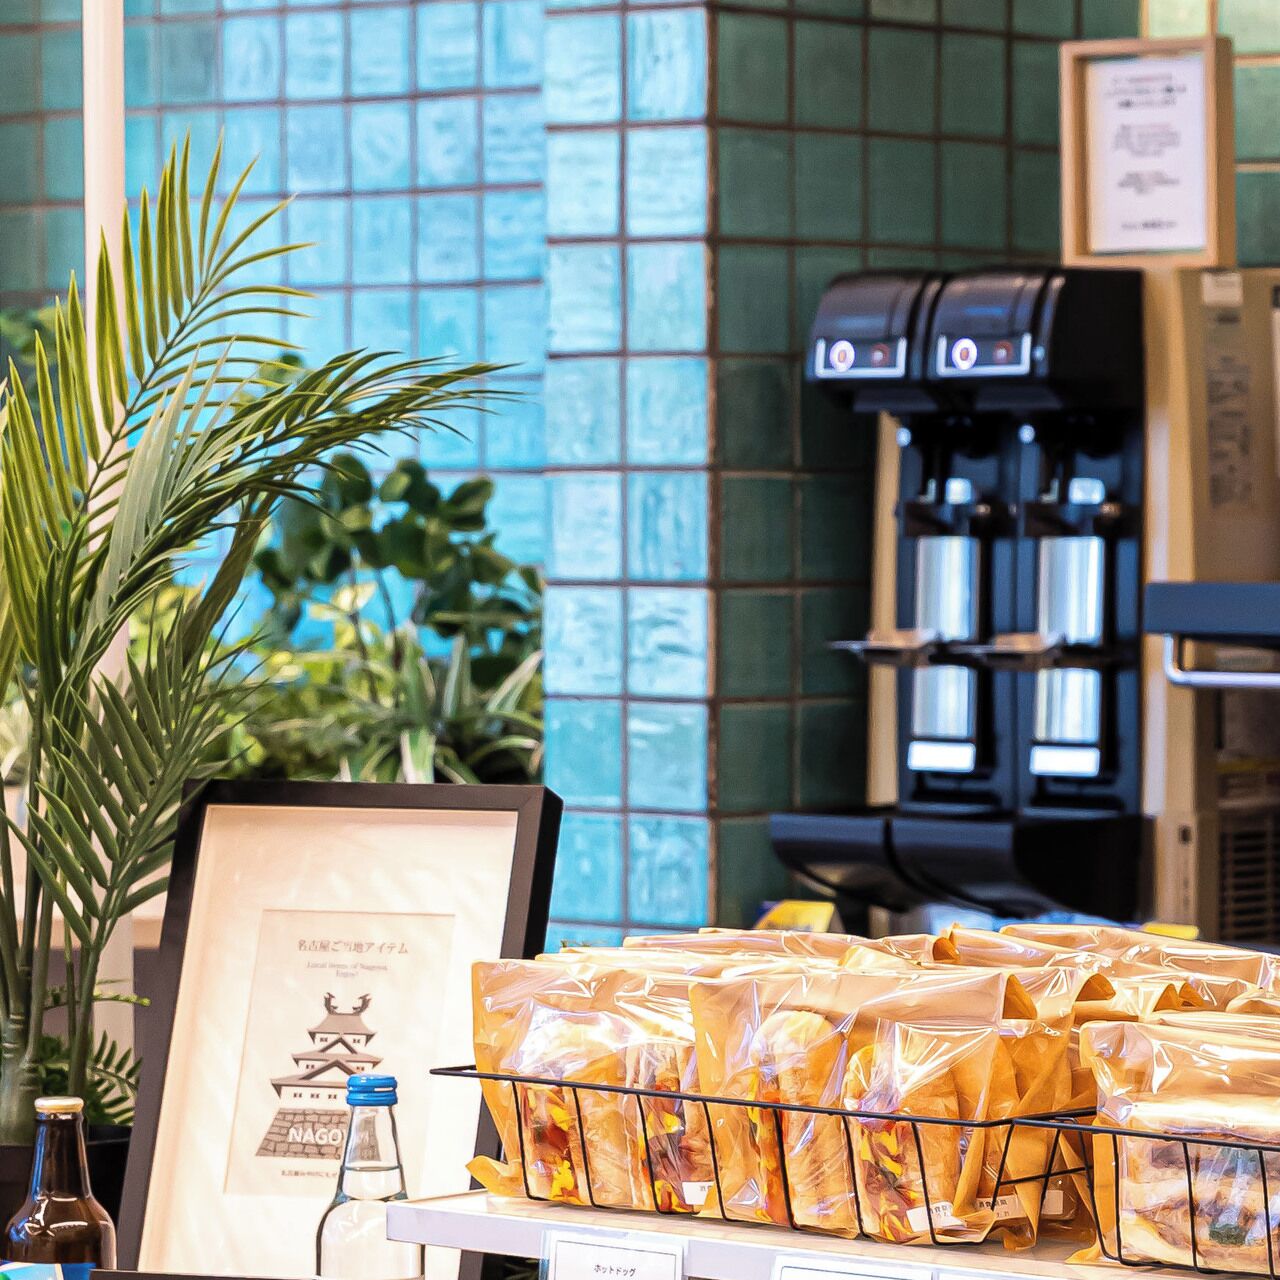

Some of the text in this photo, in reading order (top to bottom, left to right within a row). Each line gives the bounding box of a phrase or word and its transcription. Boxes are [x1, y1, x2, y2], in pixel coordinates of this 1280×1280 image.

[297, 939, 408, 954] 名古屋ご当地アイテム
[594, 1264, 637, 1278] ホットドッグ
